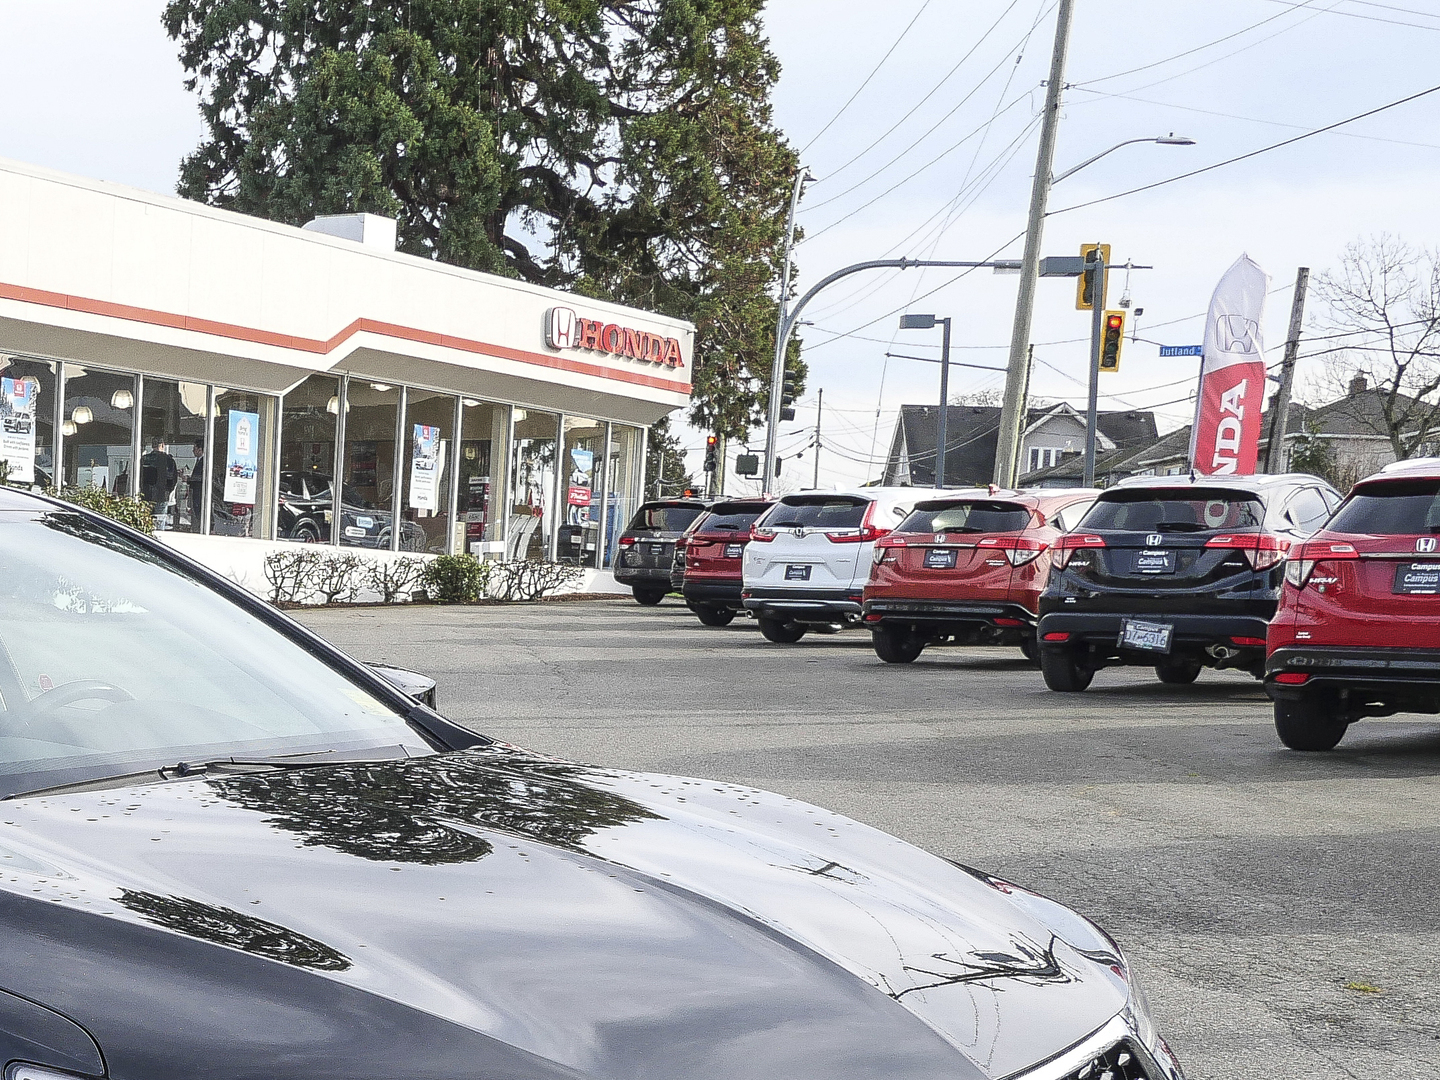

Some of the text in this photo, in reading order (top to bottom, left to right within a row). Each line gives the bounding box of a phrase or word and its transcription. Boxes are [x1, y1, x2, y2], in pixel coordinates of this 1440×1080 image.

[578, 317, 685, 368] HONDA
[1160, 346, 1195, 356] Jutland
[1403, 573, 1439, 584] Campus
